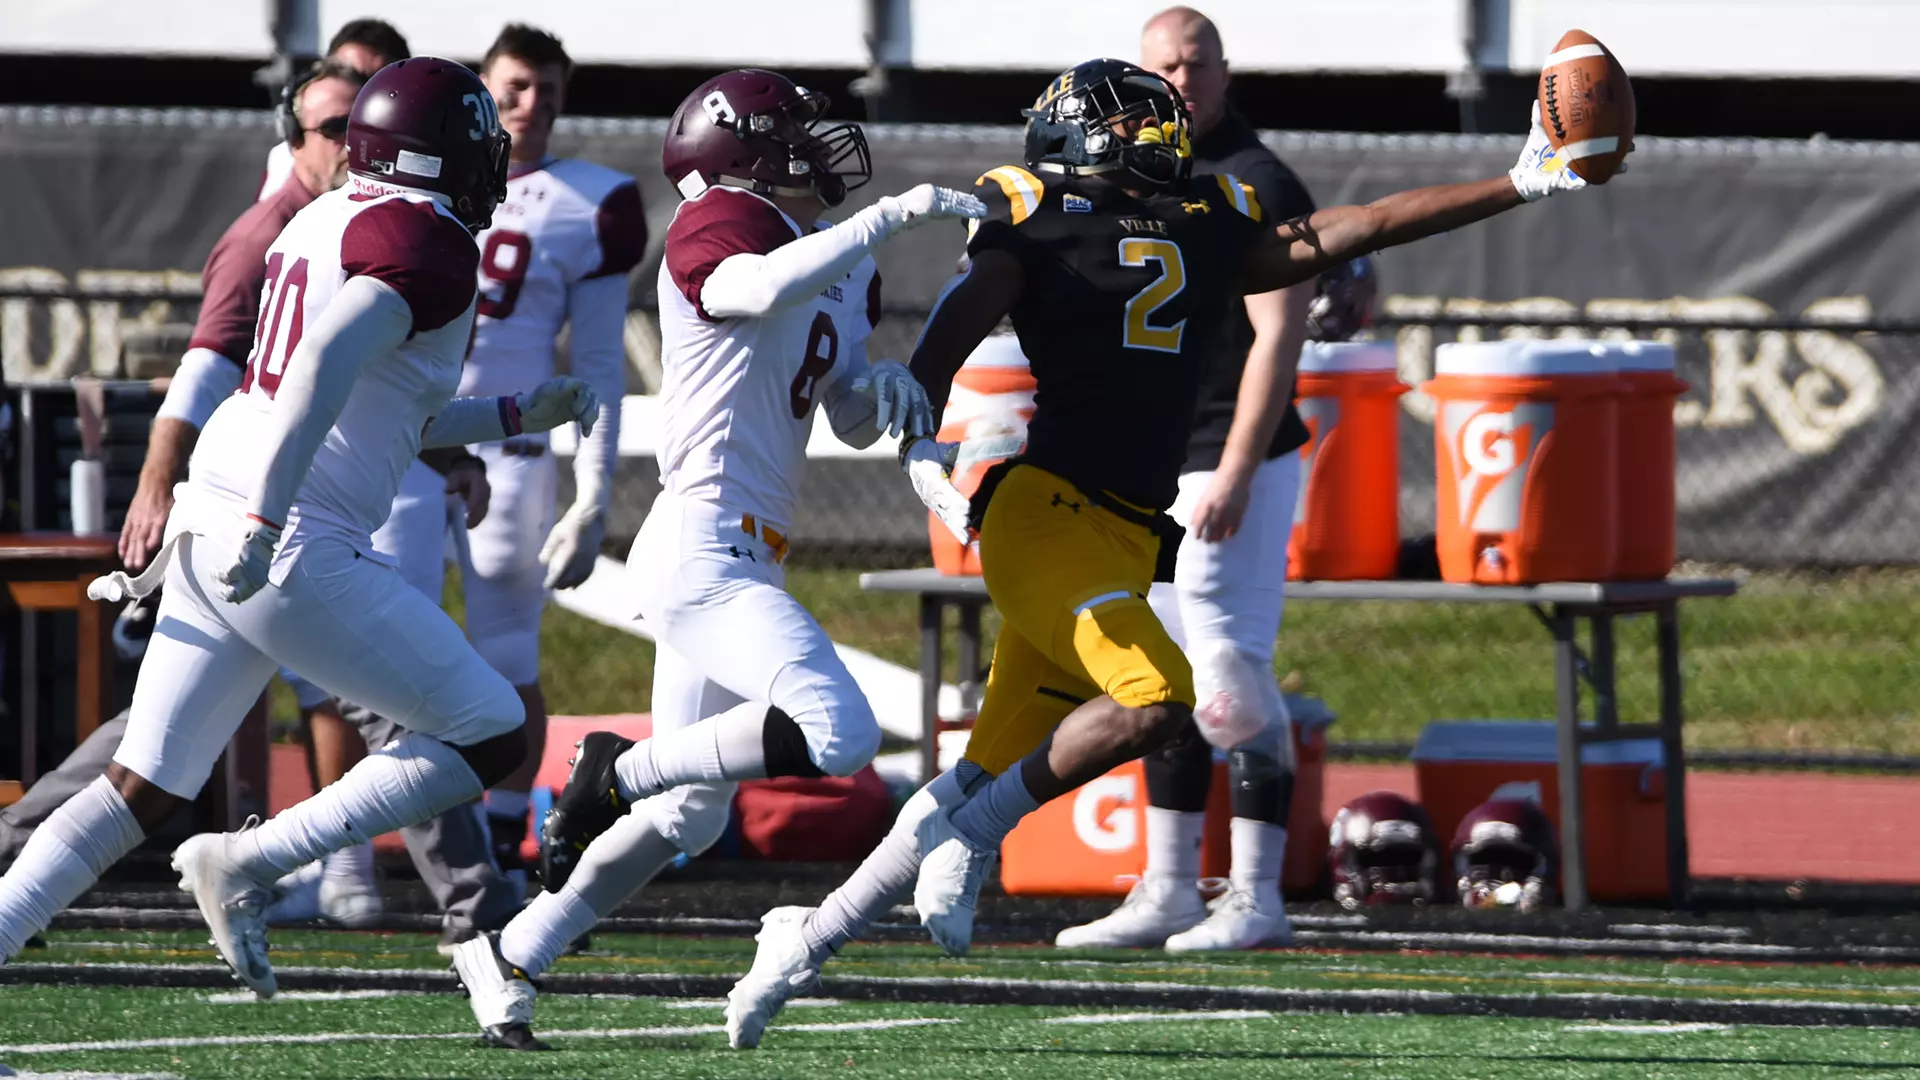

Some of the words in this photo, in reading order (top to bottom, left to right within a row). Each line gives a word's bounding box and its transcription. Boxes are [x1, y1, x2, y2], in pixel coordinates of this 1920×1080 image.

[462, 91, 499, 141] 30
[702, 91, 736, 125] 8
[1119, 218, 1168, 236] VILLE
[478, 229, 532, 320] 9
[1118, 237, 1187, 354] 2
[790, 309, 838, 420] 8
[1462, 411, 1515, 475] G
[1072, 774, 1137, 852] G
